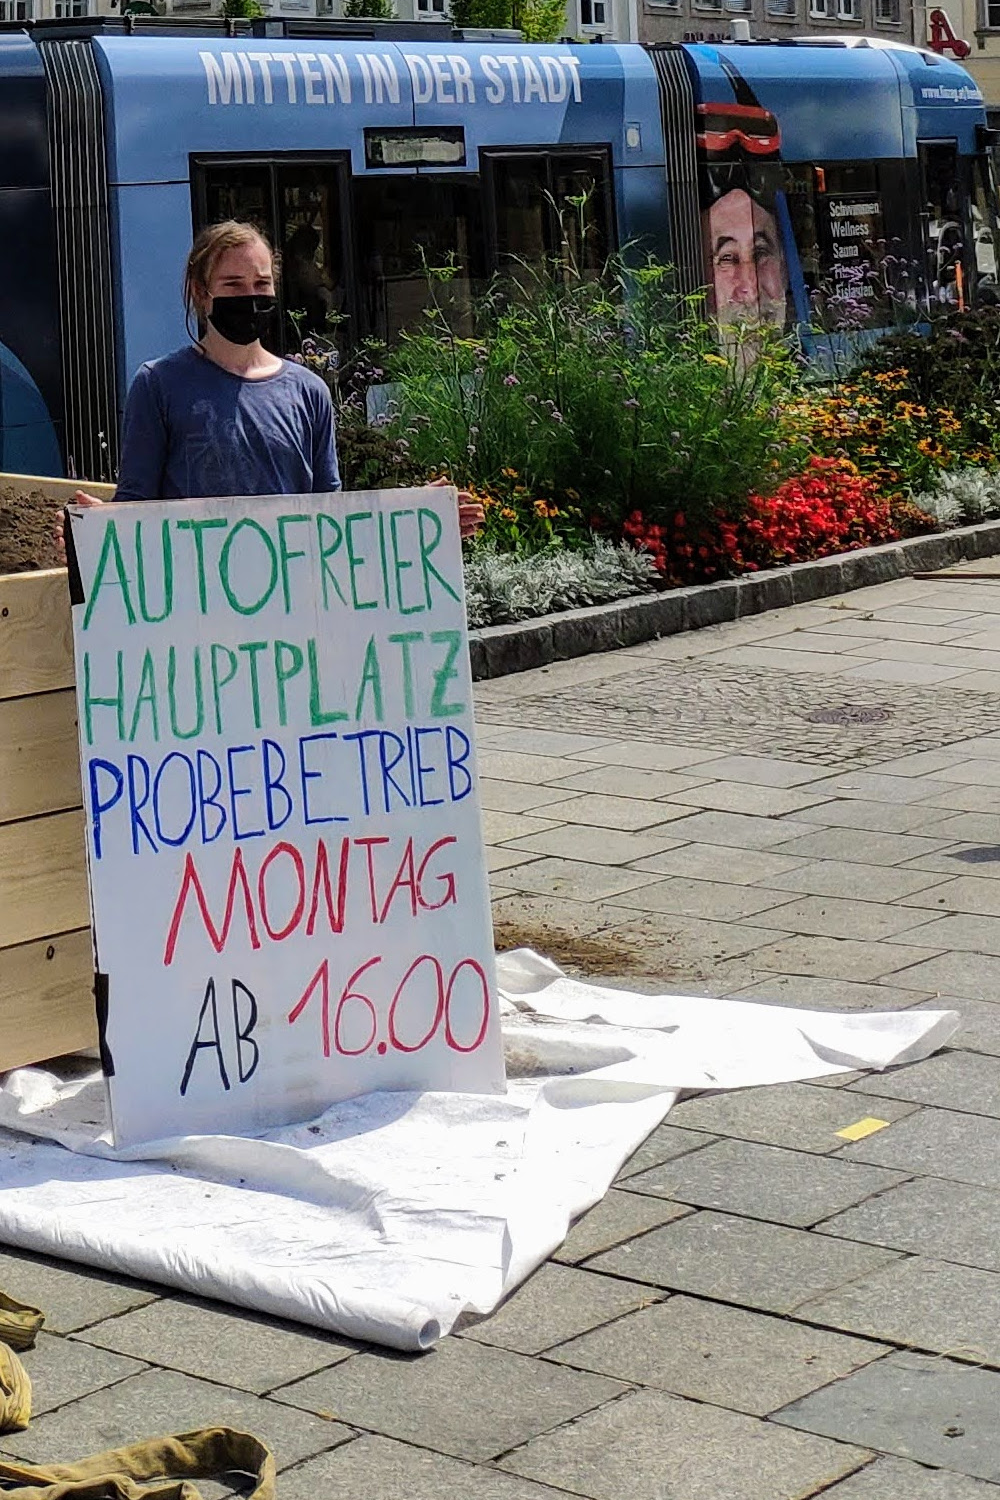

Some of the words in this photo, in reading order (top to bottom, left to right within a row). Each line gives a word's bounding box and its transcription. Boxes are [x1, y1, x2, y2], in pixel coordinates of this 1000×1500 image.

[199, 52, 351, 105] MITTEN
[355, 53, 400, 105] IN
[402, 54, 476, 104] DER
[480, 55, 583, 104] STADT
[830, 221, 869, 237] Wellness
[832, 243, 859, 258] Sauna
[82, 507, 462, 630] AUTOFREIER
[83, 630, 466, 745] HAUPTPLATZ
[88, 726, 473, 860] PROBEBETRIEB
[163, 836, 458, 966] MONTAG
[180, 976, 260, 1096] AB
[288, 954, 491, 1058] 16.00
